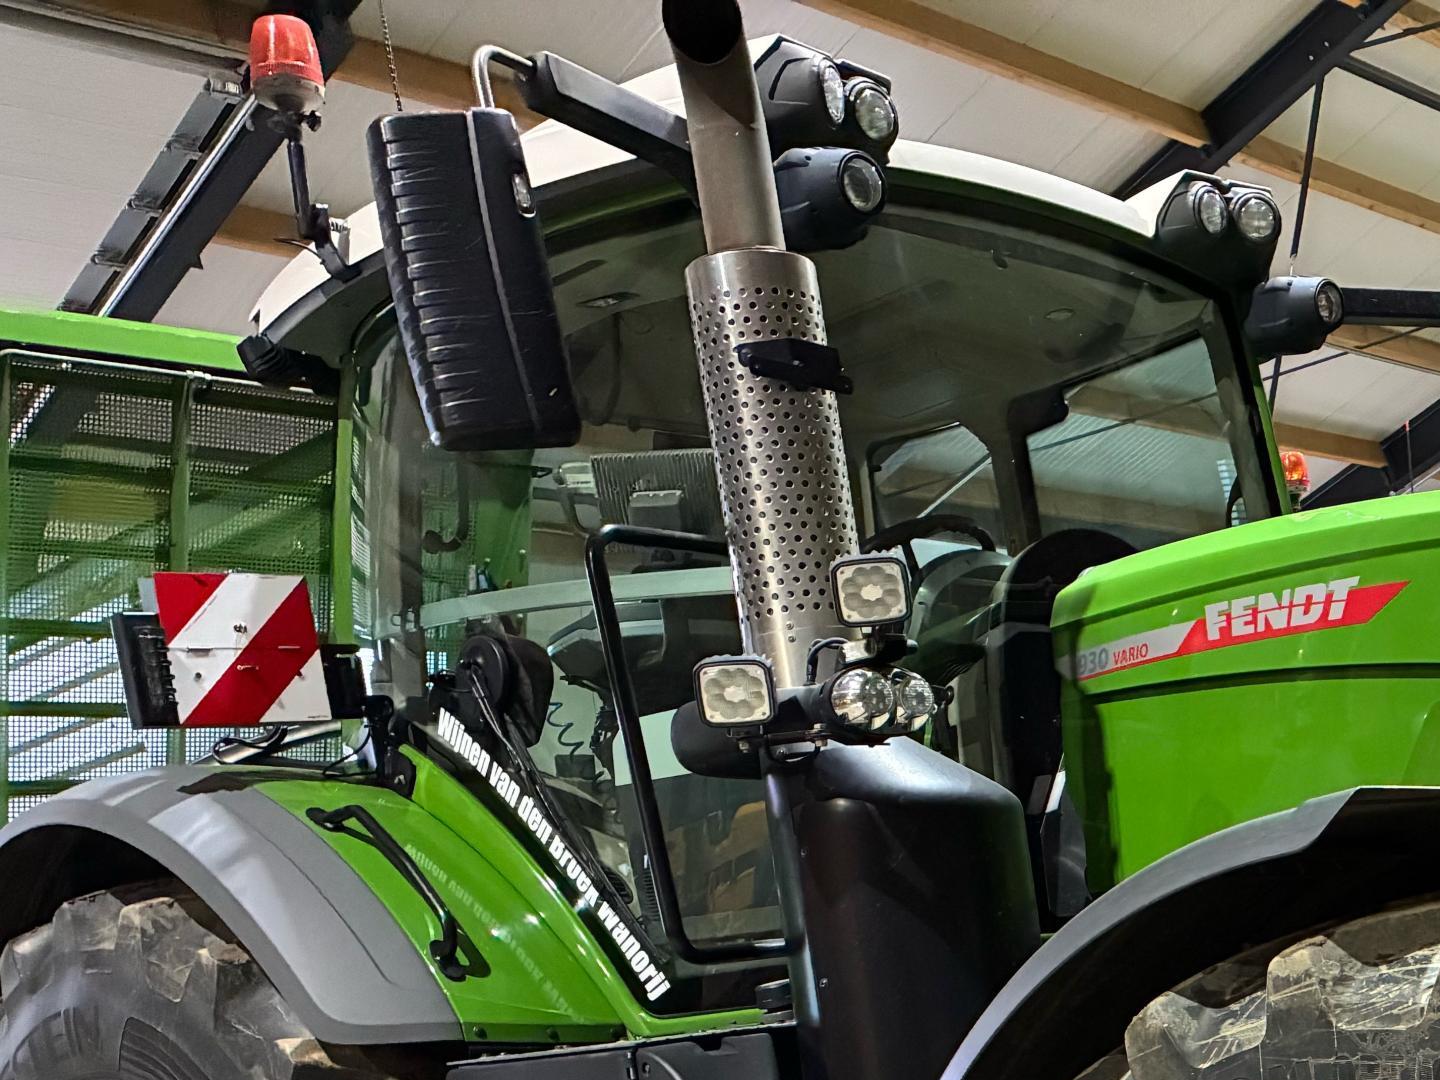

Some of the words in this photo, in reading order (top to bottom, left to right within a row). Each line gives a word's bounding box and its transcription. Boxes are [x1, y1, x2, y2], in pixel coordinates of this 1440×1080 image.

[1204, 576, 1360, 641] FENDT
[1077, 647, 1109, 675] 930
[1113, 643, 1149, 666] VARIO
[437, 706, 491, 778] Wijnen
[488, 761, 521, 809] van
[517, 794, 553, 845] den
